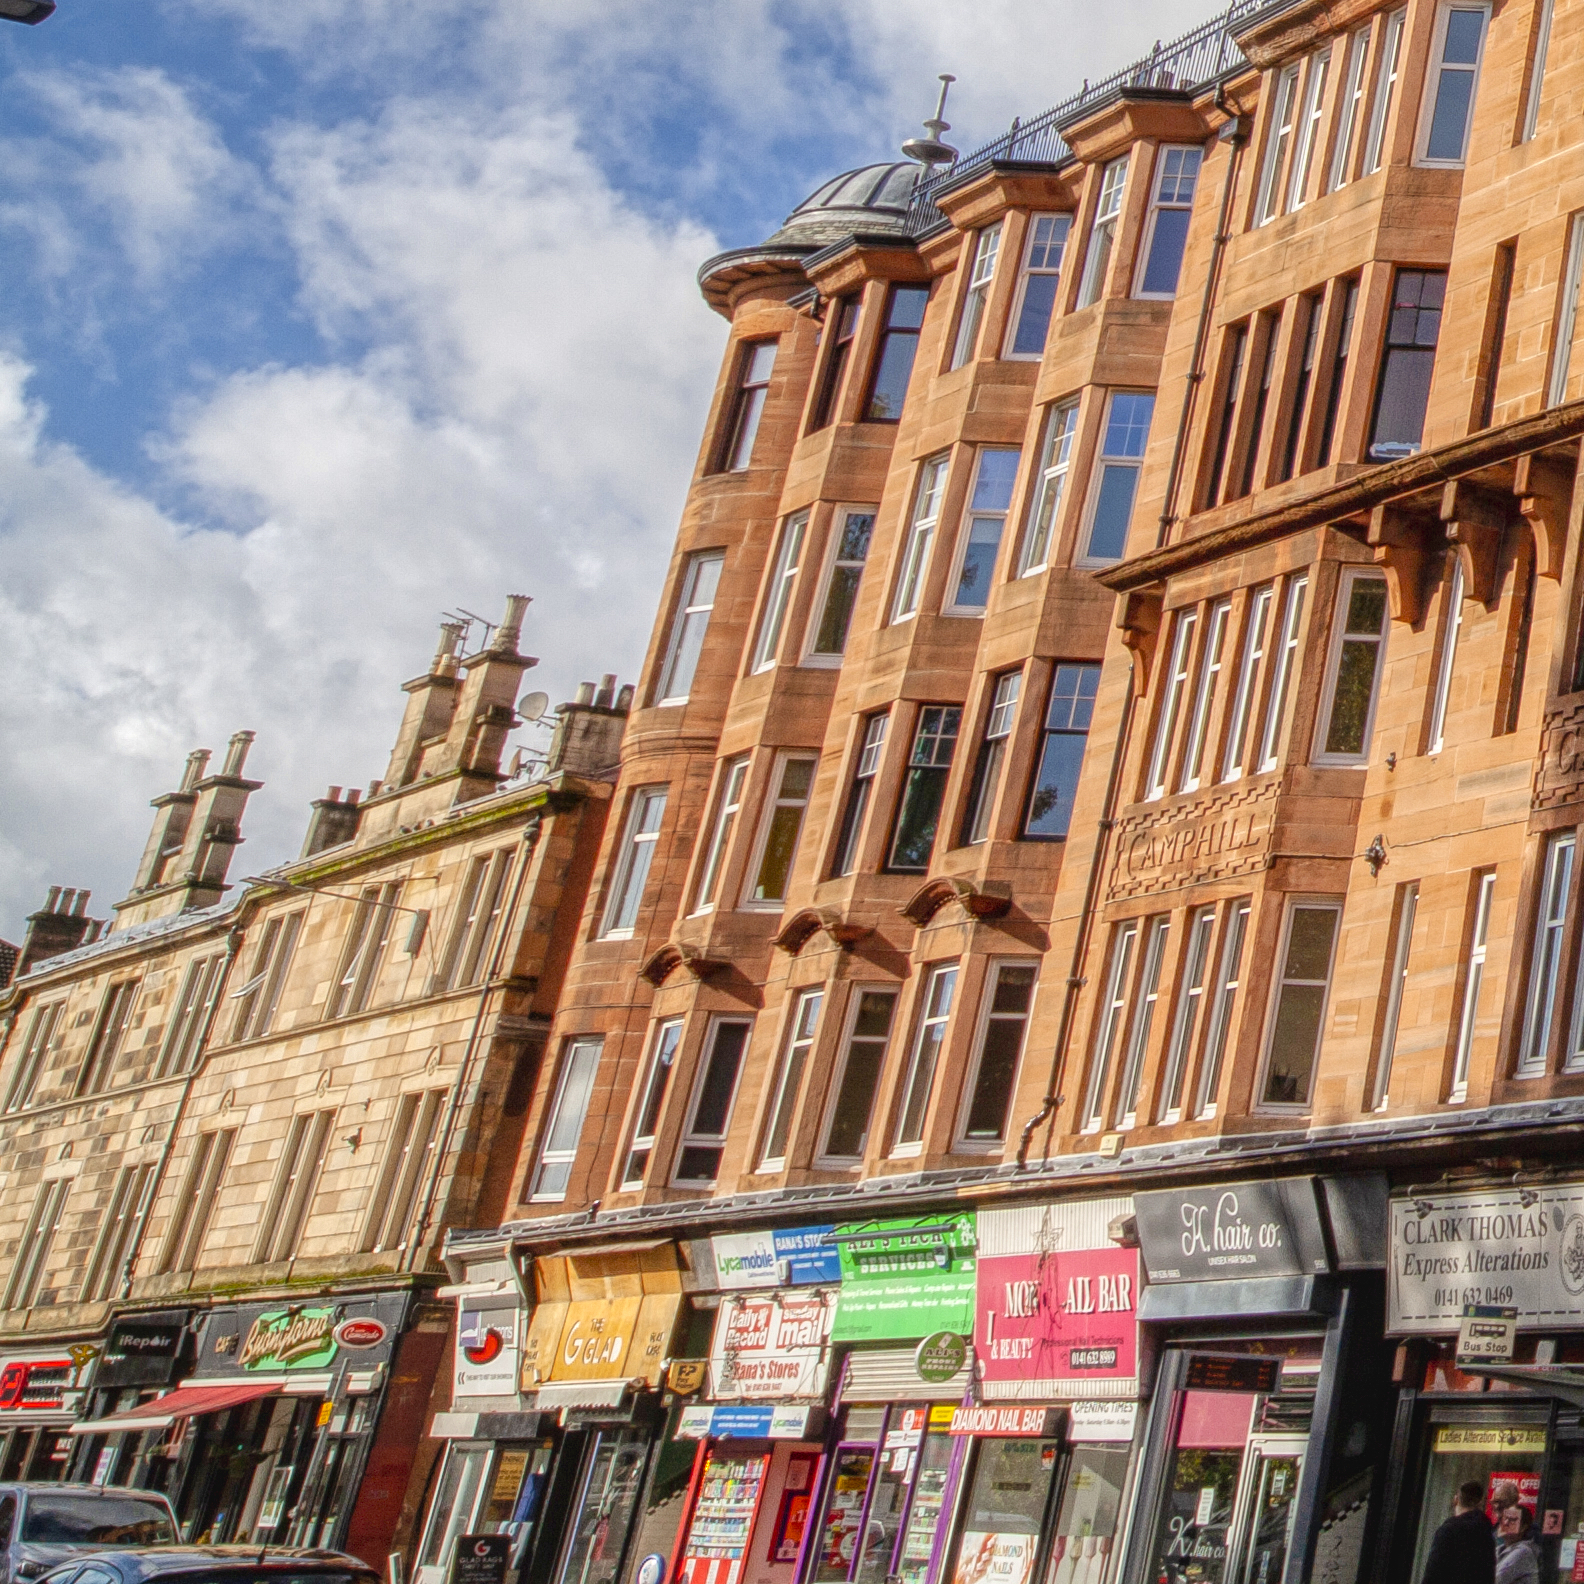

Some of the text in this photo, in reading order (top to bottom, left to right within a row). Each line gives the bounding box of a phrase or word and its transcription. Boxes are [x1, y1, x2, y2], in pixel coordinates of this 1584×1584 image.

[1127, 813, 1261, 881] CAMPHILL
[1214, 1191, 1254, 1252] hair
[1258, 1222, 1282, 1248] co.
[1403, 1211, 1548, 1245] CLARK THOMAS
[775, 1234, 804, 1252] RANA'S
[717, 1246, 774, 1276] Lycamobile
[859, 1252, 936, 1274] SERVICES
[1208, 1255, 1227, 1266] UNISEX
[1239, 1254, 1257, 1264] SALON
[1402, 1246, 1550, 1282] Express Alterations
[1064, 1273, 1132, 1314] AIL BAR
[1434, 1285, 1513, 1307] 0141 632 0469
[590, 1317, 606, 1333] THE
[729, 1308, 759, 1332] Daily
[237, 1314, 331, 1365] Buongiorno
[725, 1328, 769, 1348] Record
[777, 1320, 822, 1346] mail
[1041, 1336, 1077, 1348] Professional
[1090, 1335, 1124, 1346] Technicians
[582, 1336, 624, 1365] GLAD
[925, 1347, 962, 1357] ALI'S
[990, 1337, 1035, 1360] & BEAUTY
[1071, 1347, 1099, 1365] 0141 632
[1463, 1341, 1508, 1353] Bus Stop
[676, 1376, 690, 1384] Pay
[734, 1359, 801, 1381] Rana's Stores
[675, 1382, 694, 1390] Point
[1074, 1400, 1133, 1414] OPENING TIMES
[949, 1408, 997, 1431] DIAMOND
[996, 1409, 1022, 1432] NAIL
[1020, 1409, 1047, 1432] BAR
[1440, 1429, 1497, 1444] Ladies Alteration
[991, 1561, 1013, 1575] NAILS
